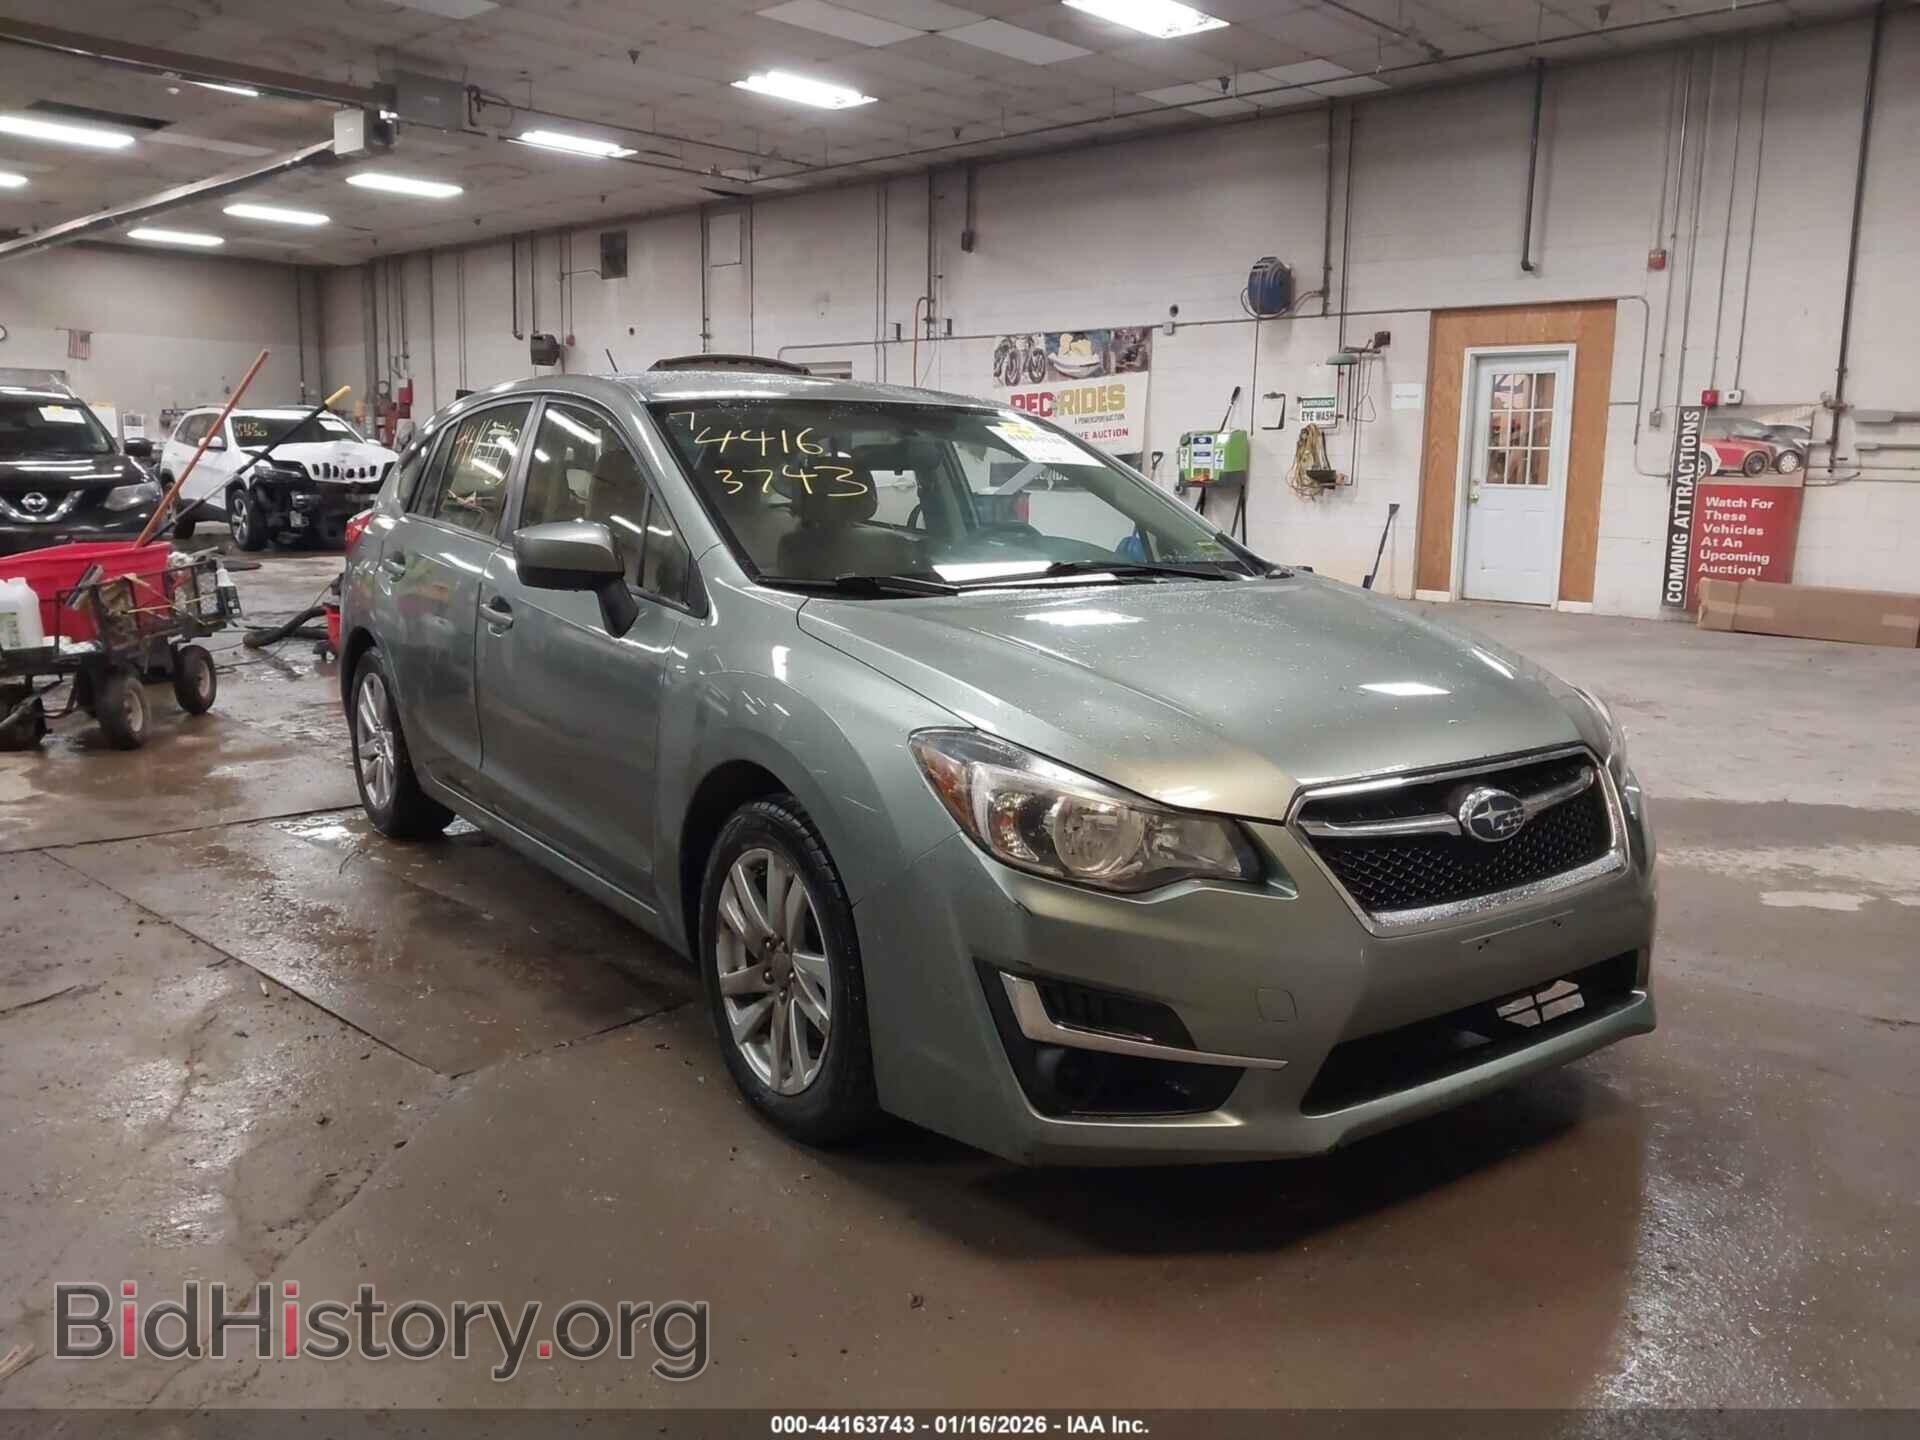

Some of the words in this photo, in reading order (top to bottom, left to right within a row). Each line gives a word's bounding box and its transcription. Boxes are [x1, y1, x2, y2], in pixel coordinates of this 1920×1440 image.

[1057, 383, 1126, 416] RIDES
[1302, 410, 1314, 421] EYE
[1092, 428, 1129, 439] AUCTION
[694, 427, 824, 457] 4416
[1675, 411, 1700, 528] ATTRACTIONS
[714, 464, 868, 497] 3743
[1706, 496, 1747, 508] Watch
[1751, 498, 1774, 509] For
[1704, 510, 1747, 521] These
[1703, 523, 1764, 535] Vehicles
[1701, 537, 1720, 547] At
[1722, 538, 1743, 548] An
[1700, 550, 1770, 565] Upcoming
[1667, 533, 1689, 603] COMING
[1698, 563, 1762, 576] Auction!
